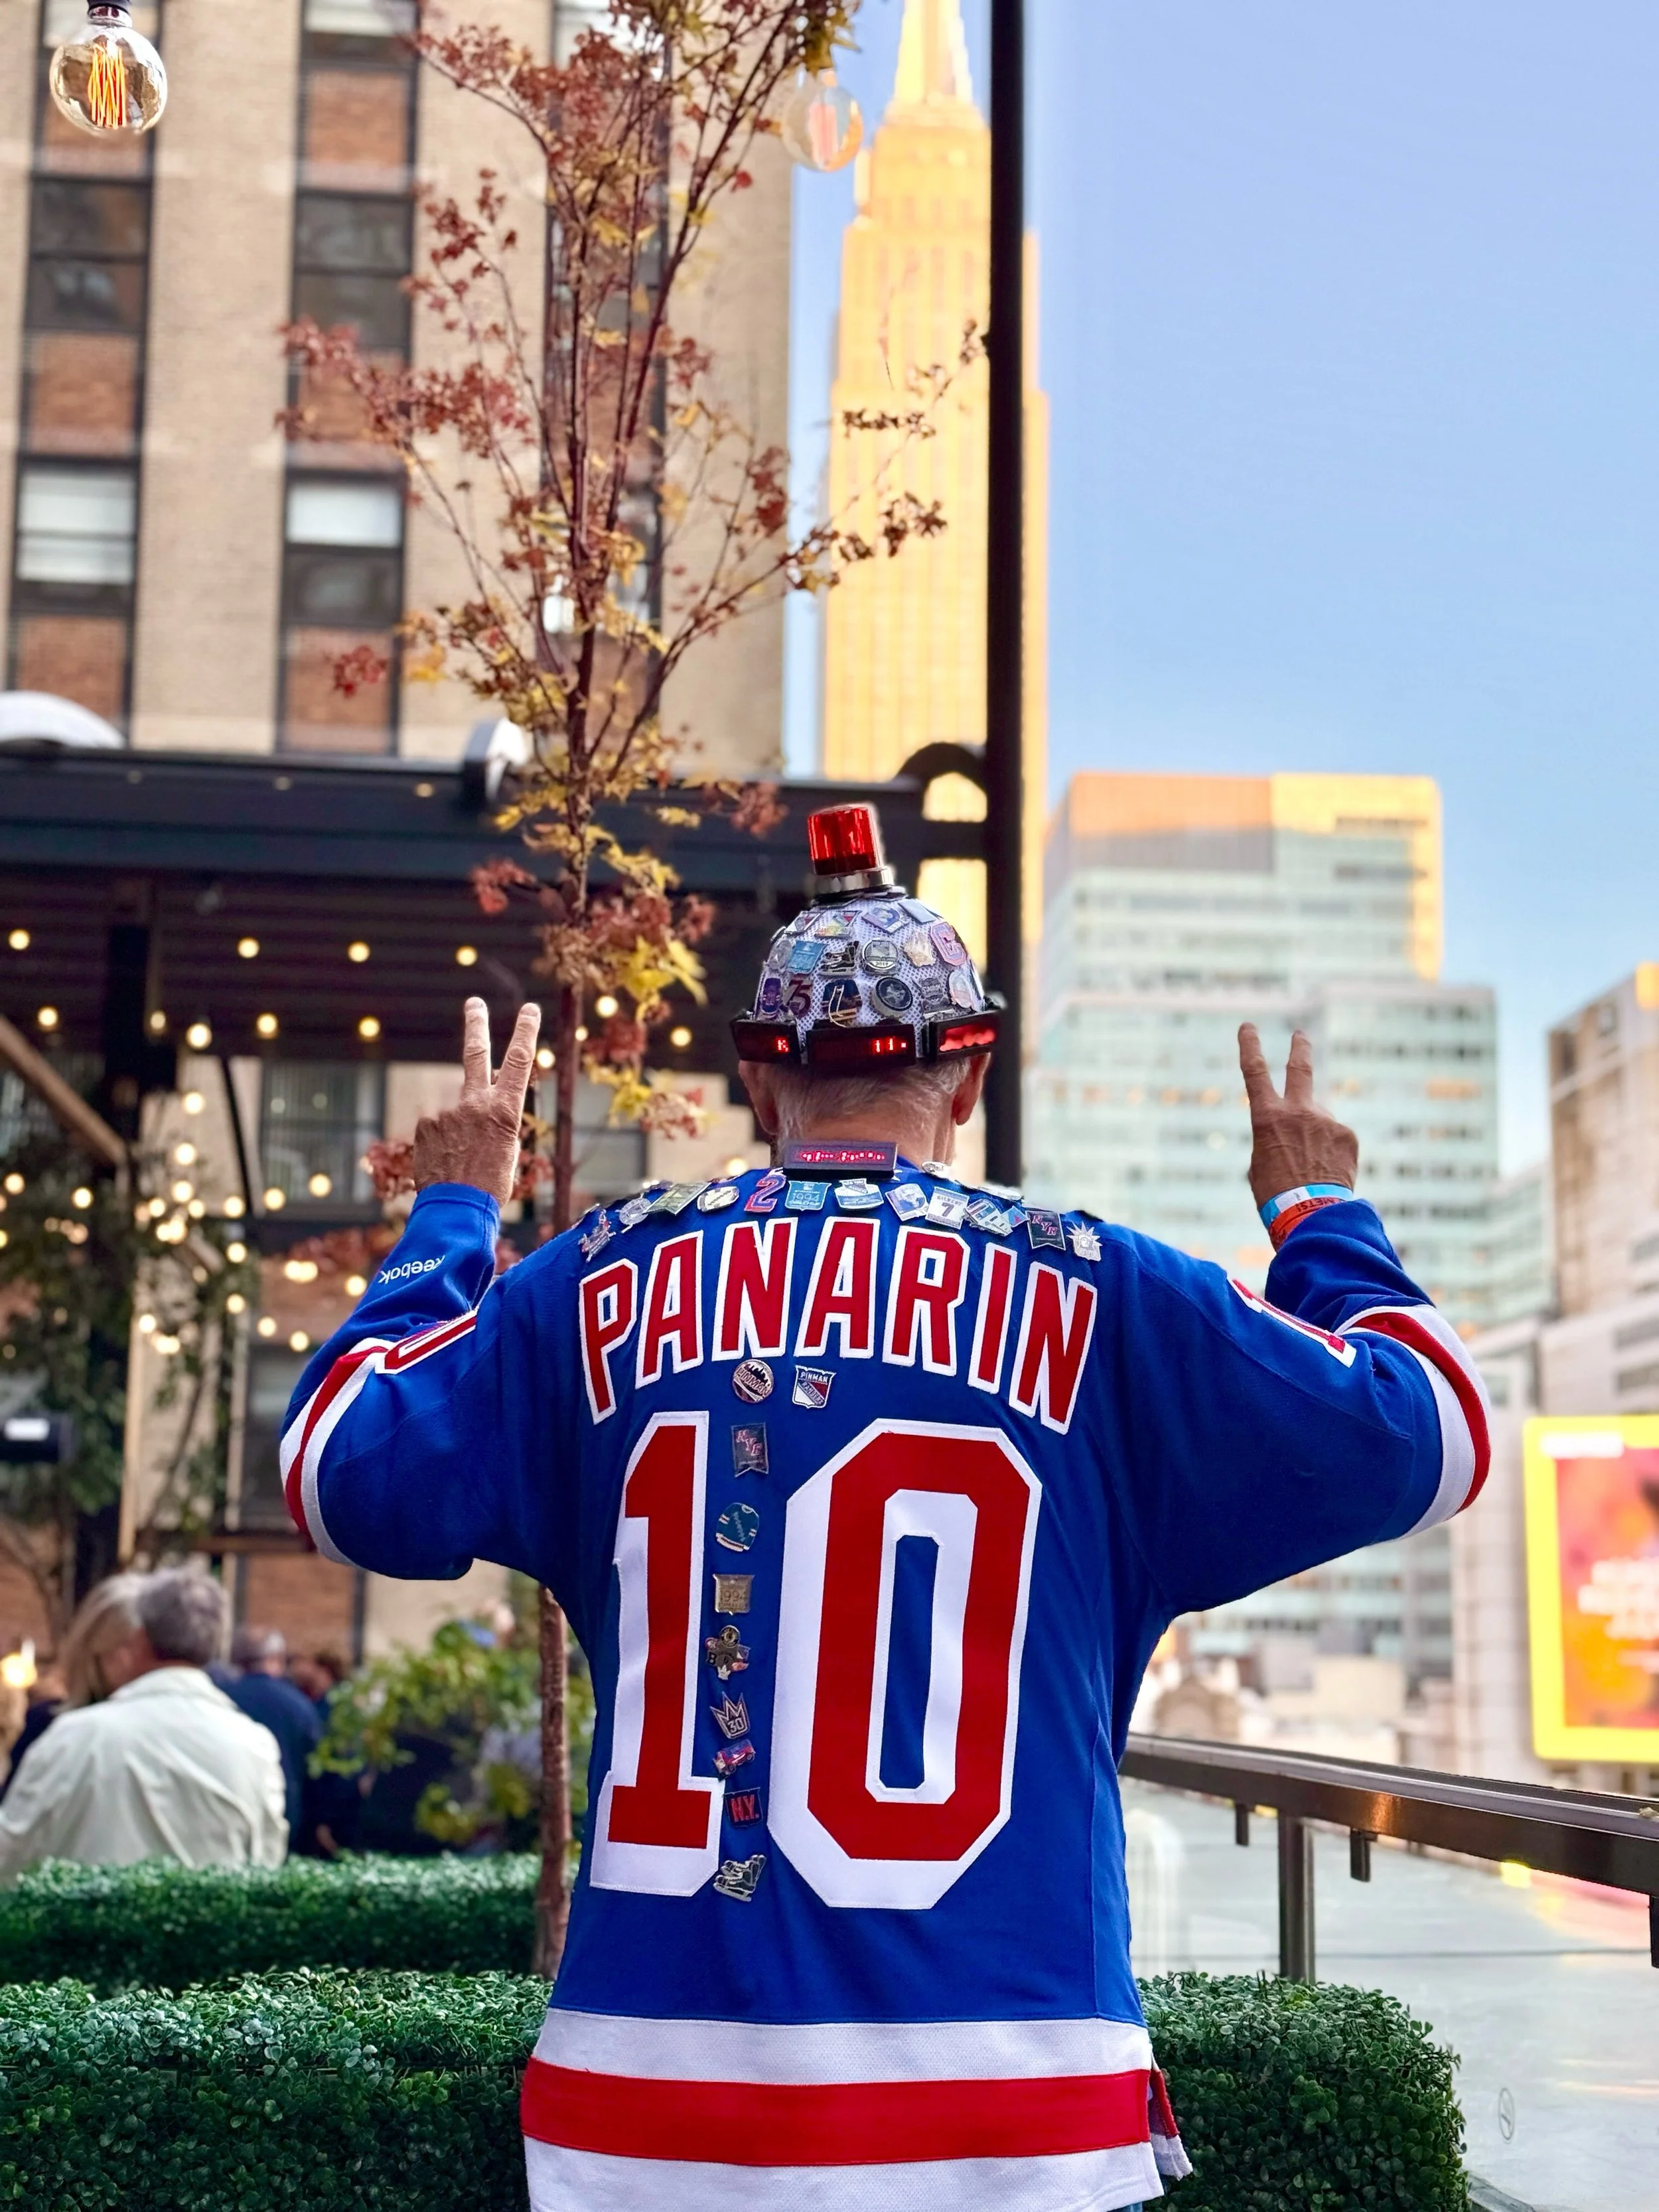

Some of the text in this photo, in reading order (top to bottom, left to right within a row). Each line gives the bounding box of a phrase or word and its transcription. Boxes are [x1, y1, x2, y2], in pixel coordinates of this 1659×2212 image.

[744, 1175, 786, 1213] 2
[792, 1193, 820, 1203] 1994
[941, 1202, 955, 1217] 7
[1031, 1215, 1058, 1236] NYR
[578, 1216, 1098, 1435] PANARIN
[737, 1366, 772, 1396] PINMAN
[800, 1371, 829, 1383] PINMAN
[590, 1410, 1043, 1909] 10
[727, 1716, 745, 1733] 30
[731, 1794, 760, 1822] N.Y.
